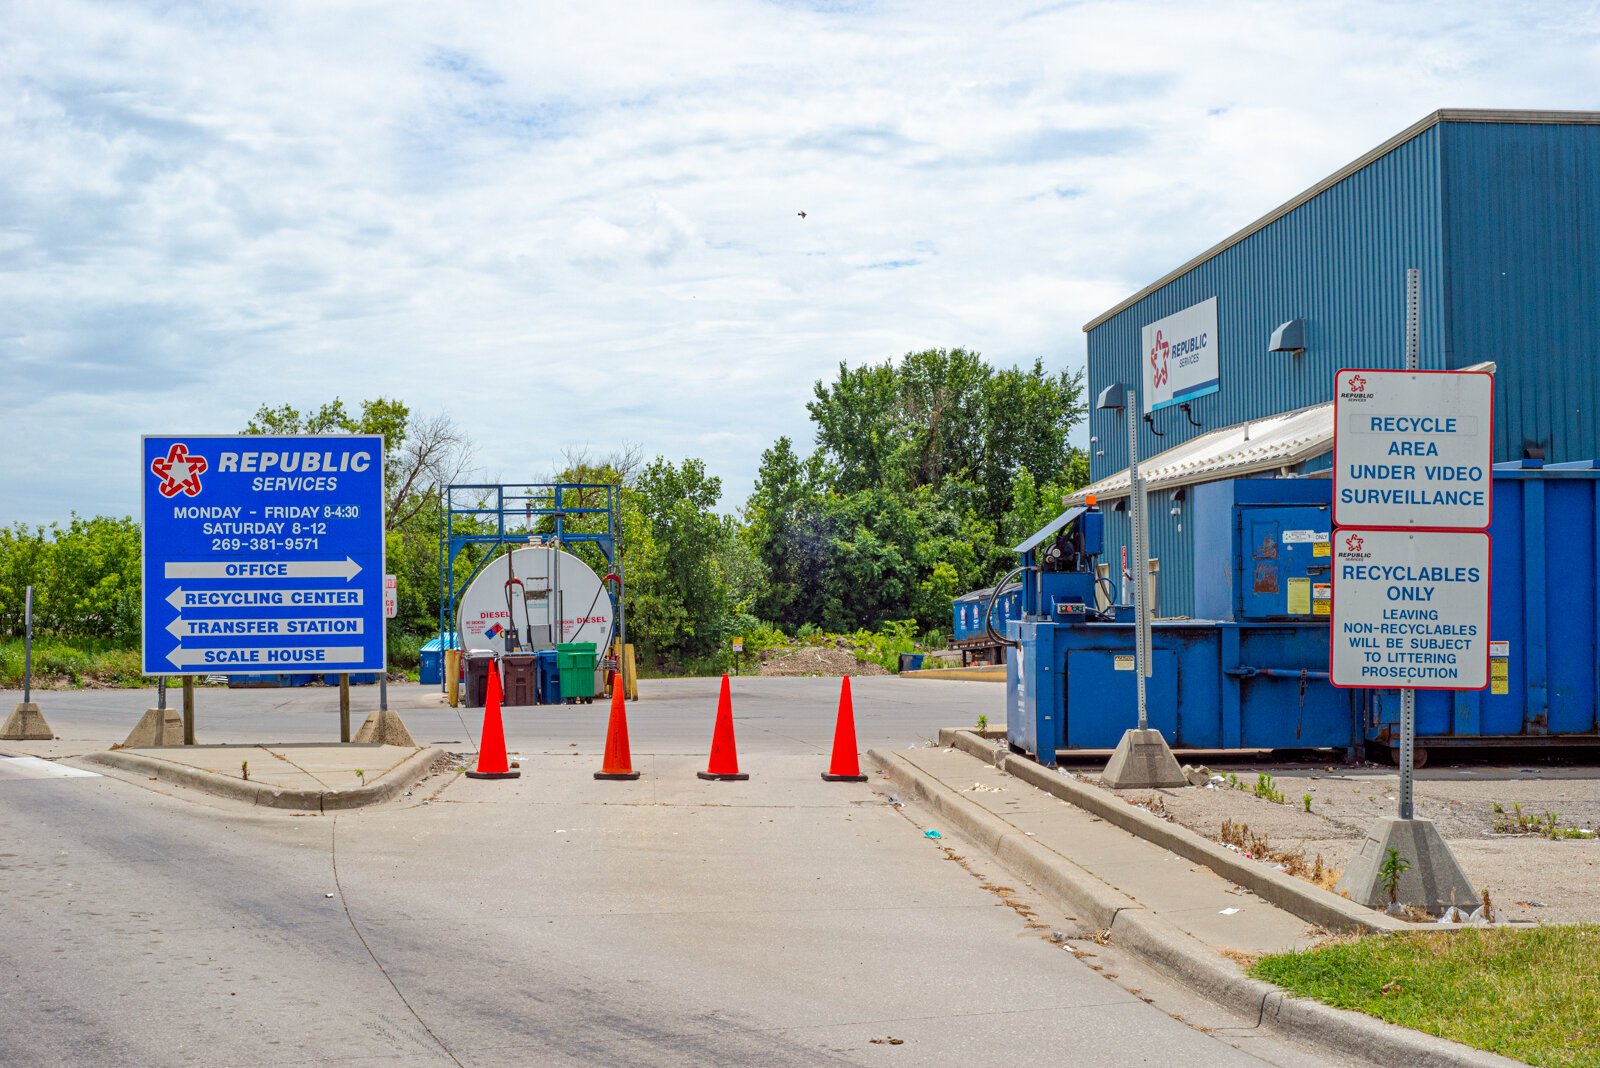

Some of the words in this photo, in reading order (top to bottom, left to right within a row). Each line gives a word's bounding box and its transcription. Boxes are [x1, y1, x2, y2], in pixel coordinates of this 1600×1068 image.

[1172, 333, 1207, 359] REPUBLIC
[1179, 352, 1200, 369] SERVICES
[1371, 416, 1457, 433] RECYCLE
[1388, 441, 1439, 457] AREA
[218, 451, 371, 473] REPUBLIC
[1350, 464, 1416, 480] UNDER
[1425, 466, 1483, 482] VIDEO
[252, 476, 338, 491] SERVICES
[1341, 488, 1485, 506] SURVEILLANCE
[174, 506, 242, 519] MONDAY
[264, 506, 320, 519] FRIDAY
[323, 506, 359, 518] 8-4:30
[203, 522, 285, 535] SATURDAY
[291, 522, 327, 535] 8-12
[212, 538, 319, 551] 269-381-9571
[225, 564, 288, 576] OFFICE
[1343, 565, 1480, 583] RECYCLABLES
[185, 592, 283, 605] RECYCLING
[291, 591, 359, 604] CENTER
[1387, 586, 1435, 601] ONLY
[480, 611, 510, 619] DIESEL
[576, 616, 607, 624] DIESEL
[1383, 609, 1438, 621] LEAVING
[188, 621, 279, 634] TRANSFER
[287, 620, 358, 633] STATION
[1344, 622, 1477, 636] NON-RECYCLABLES
[1349, 637, 1380, 648] WILL
[1386, 638, 1403, 649] BE
[1410, 638, 1472, 650] SUBJECT
[204, 650, 260, 663] SCALE
[267, 649, 326, 662] HOUSE
[1364, 651, 1381, 663] TO
[1387, 652, 1457, 664] LITTERING
[1361, 666, 1458, 679] PROSECUTION
